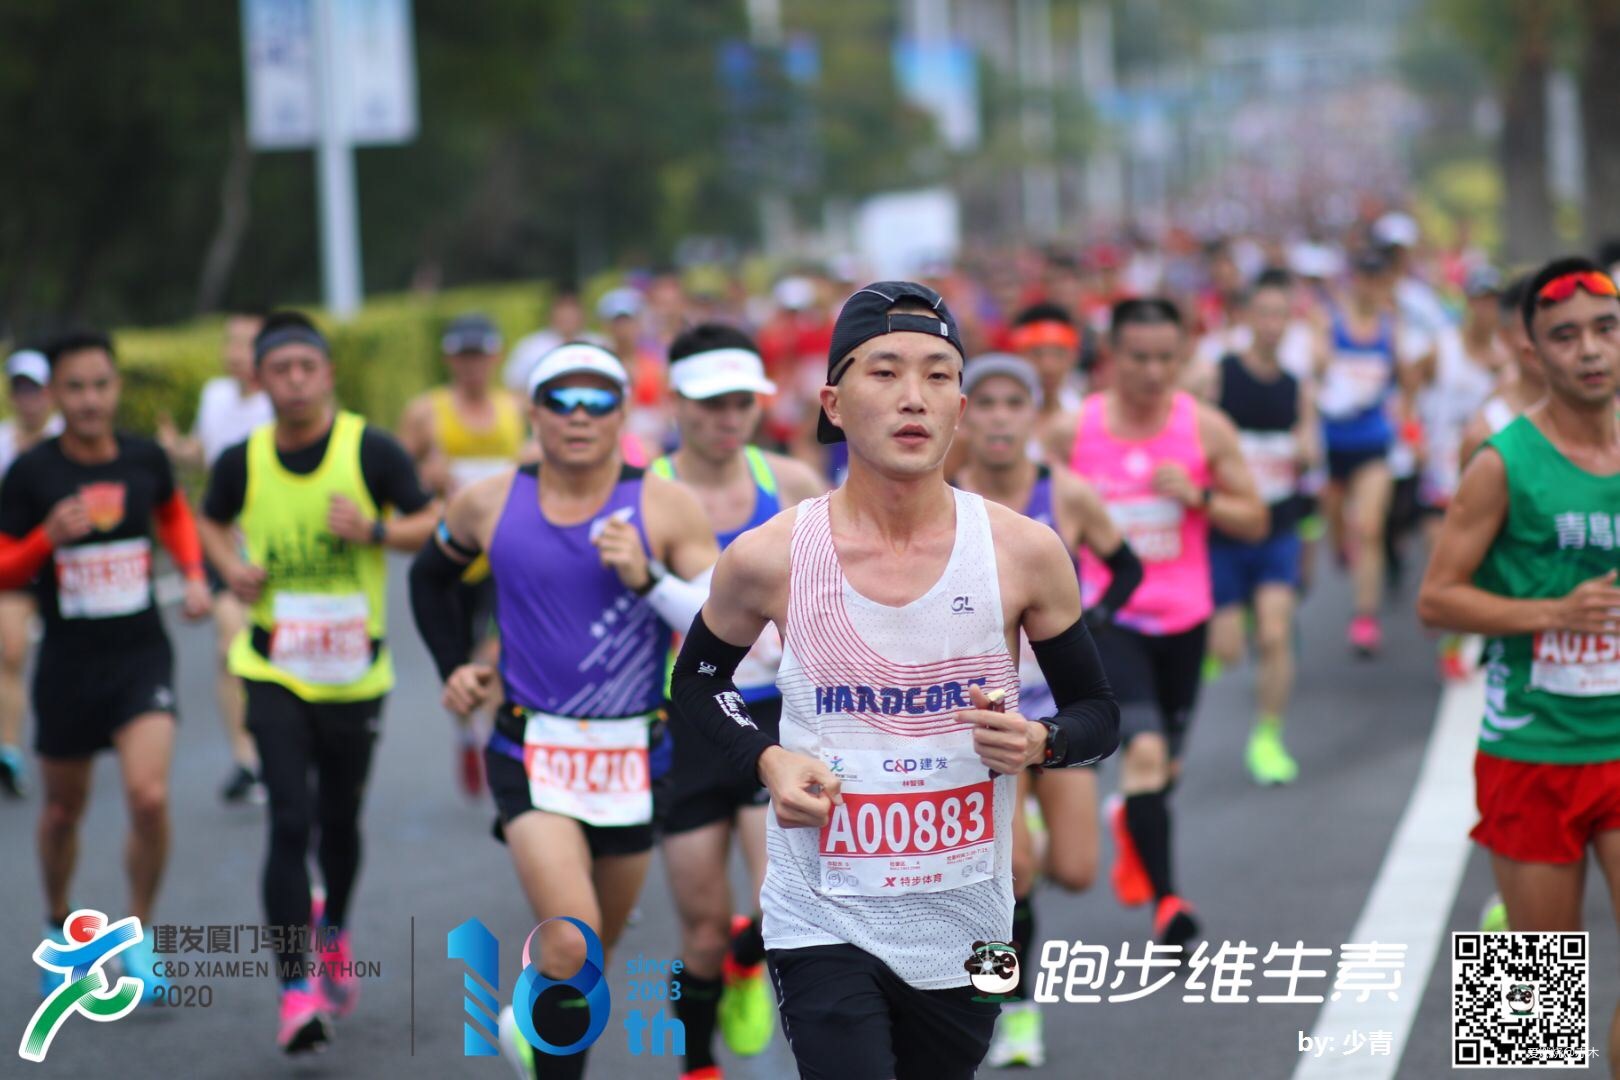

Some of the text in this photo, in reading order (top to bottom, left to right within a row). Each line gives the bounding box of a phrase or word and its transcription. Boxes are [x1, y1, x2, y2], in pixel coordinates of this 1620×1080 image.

[1554, 511, 1620, 549] 青岛
[1539, 629, 1620, 663] A015
[883, 757, 948, 773] C&D 建发
[826, 792, 985, 854] A00883
[900, 873, 943, 886] 特步体育
